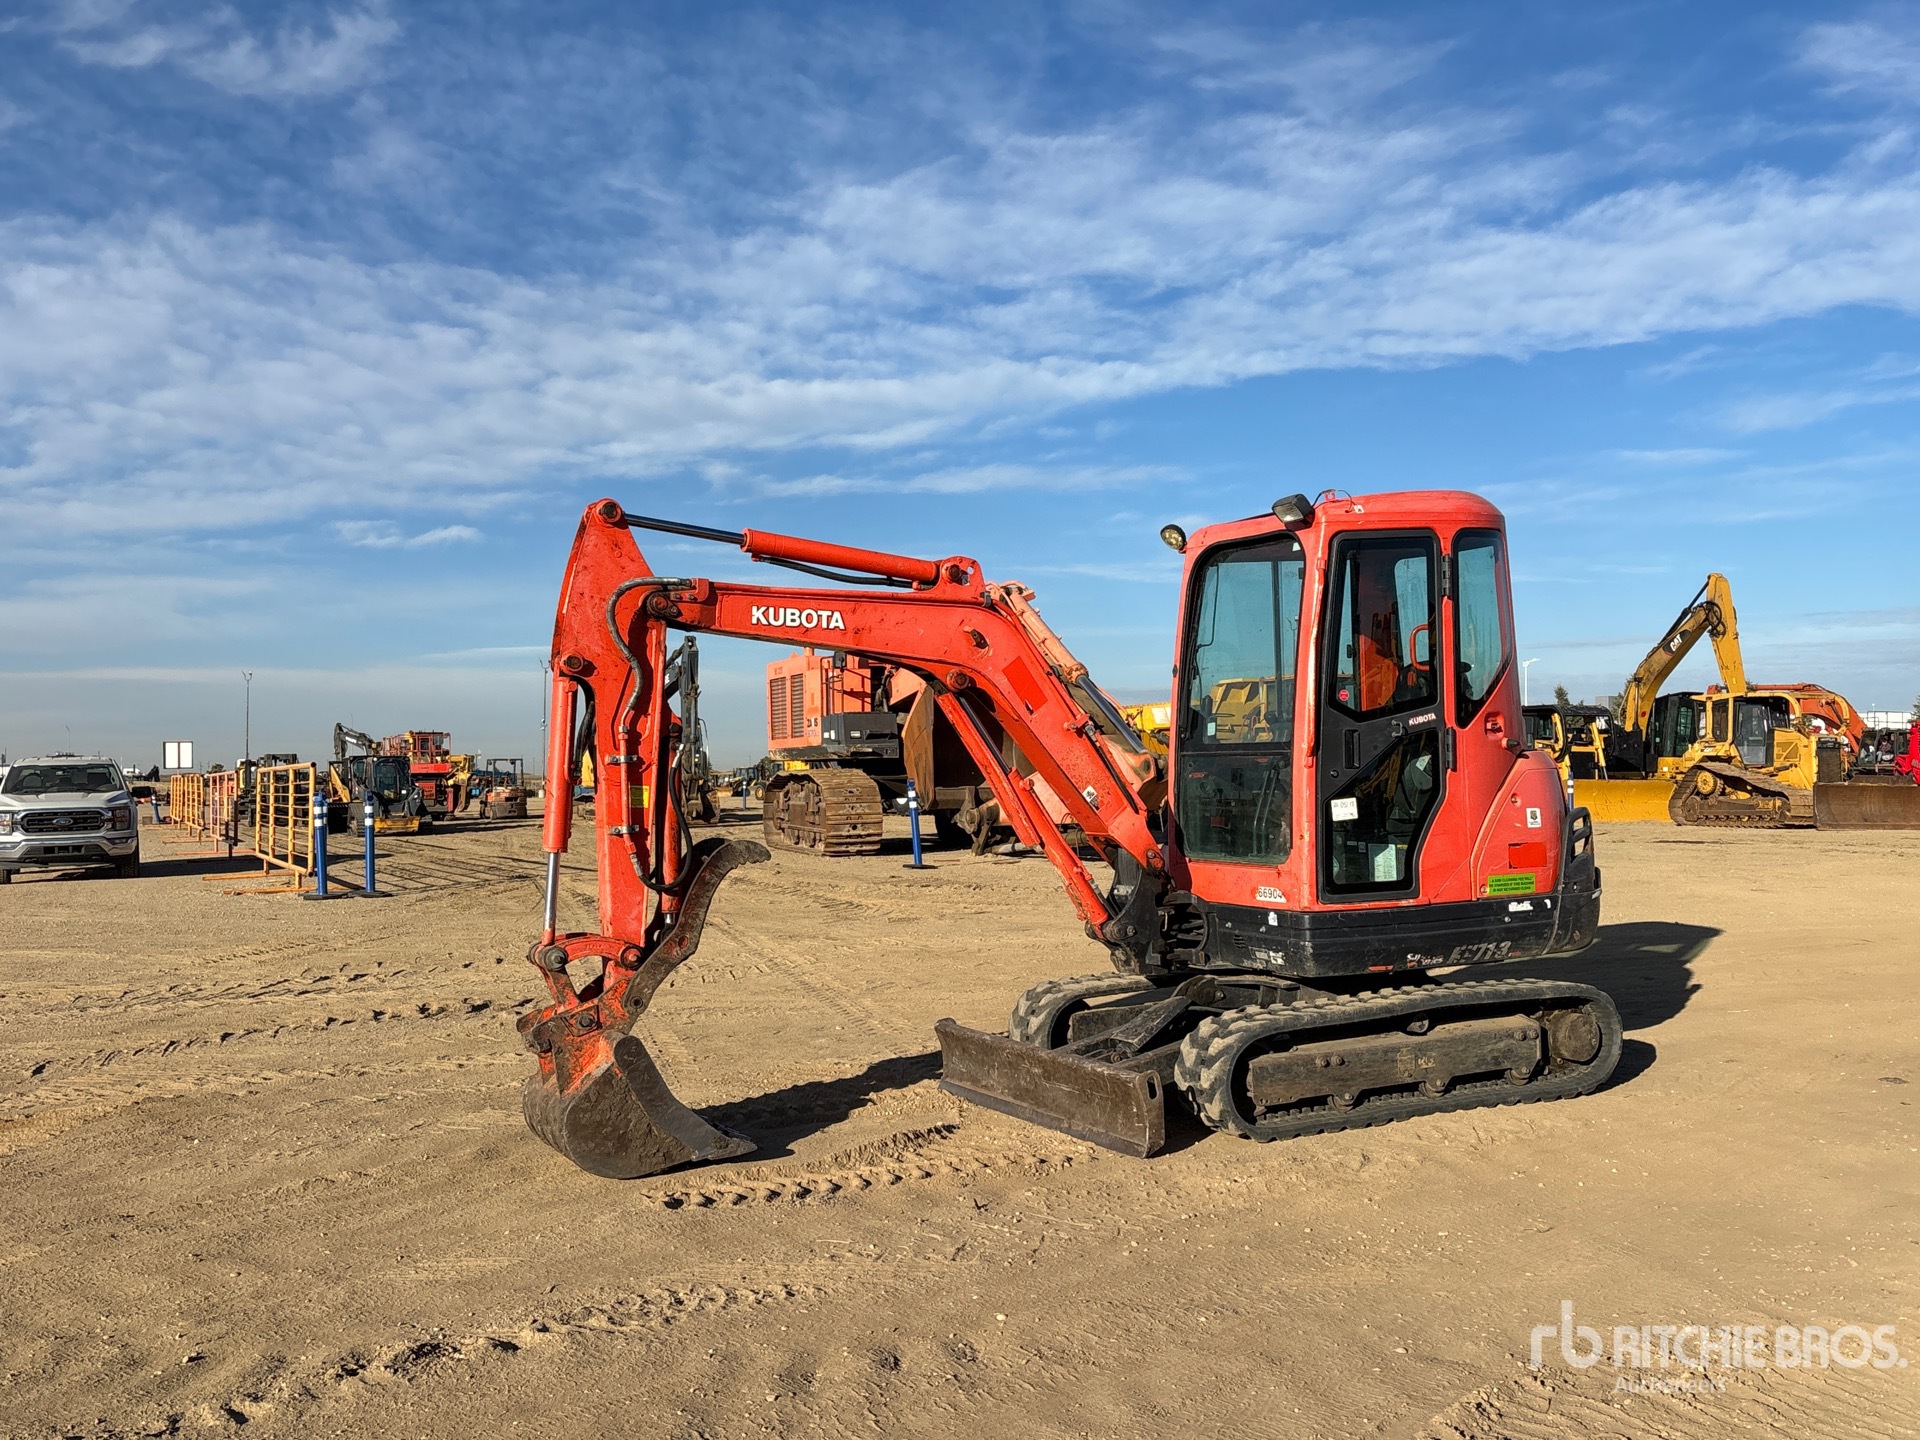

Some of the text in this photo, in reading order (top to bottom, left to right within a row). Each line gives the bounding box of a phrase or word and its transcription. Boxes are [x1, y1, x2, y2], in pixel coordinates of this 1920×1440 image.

[751, 605, 846, 630] KUBOTA
[1670, 633, 1682, 652] CAT
[1408, 712, 1437, 727] KUBOTA
